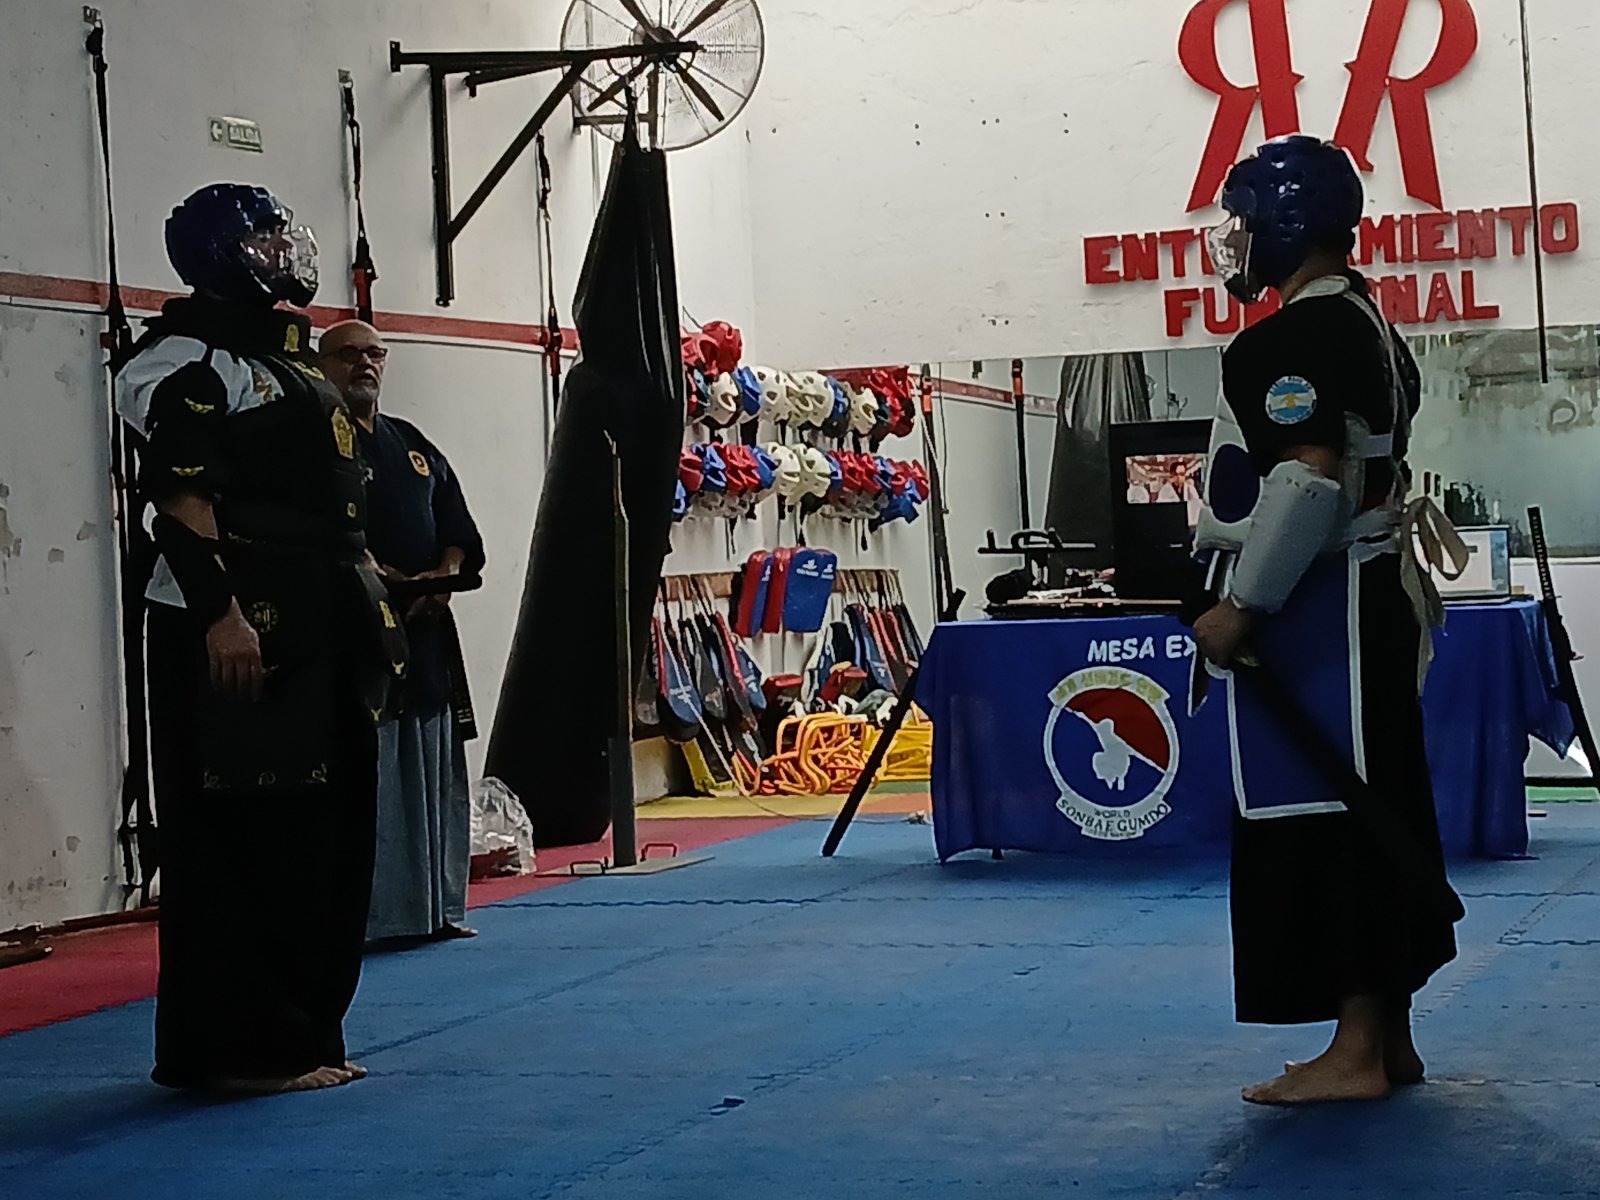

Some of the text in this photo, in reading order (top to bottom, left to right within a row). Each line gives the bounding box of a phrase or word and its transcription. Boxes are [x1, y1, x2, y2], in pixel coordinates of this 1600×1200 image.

[1083, 202, 1579, 284] ENTMIENTO
[1165, 270, 1500, 337] FUNAL
[1087, 637, 1155, 662] MESA
[1094, 808, 1131, 819] WORLD
[1117, 804, 1169, 832] GUMDO
